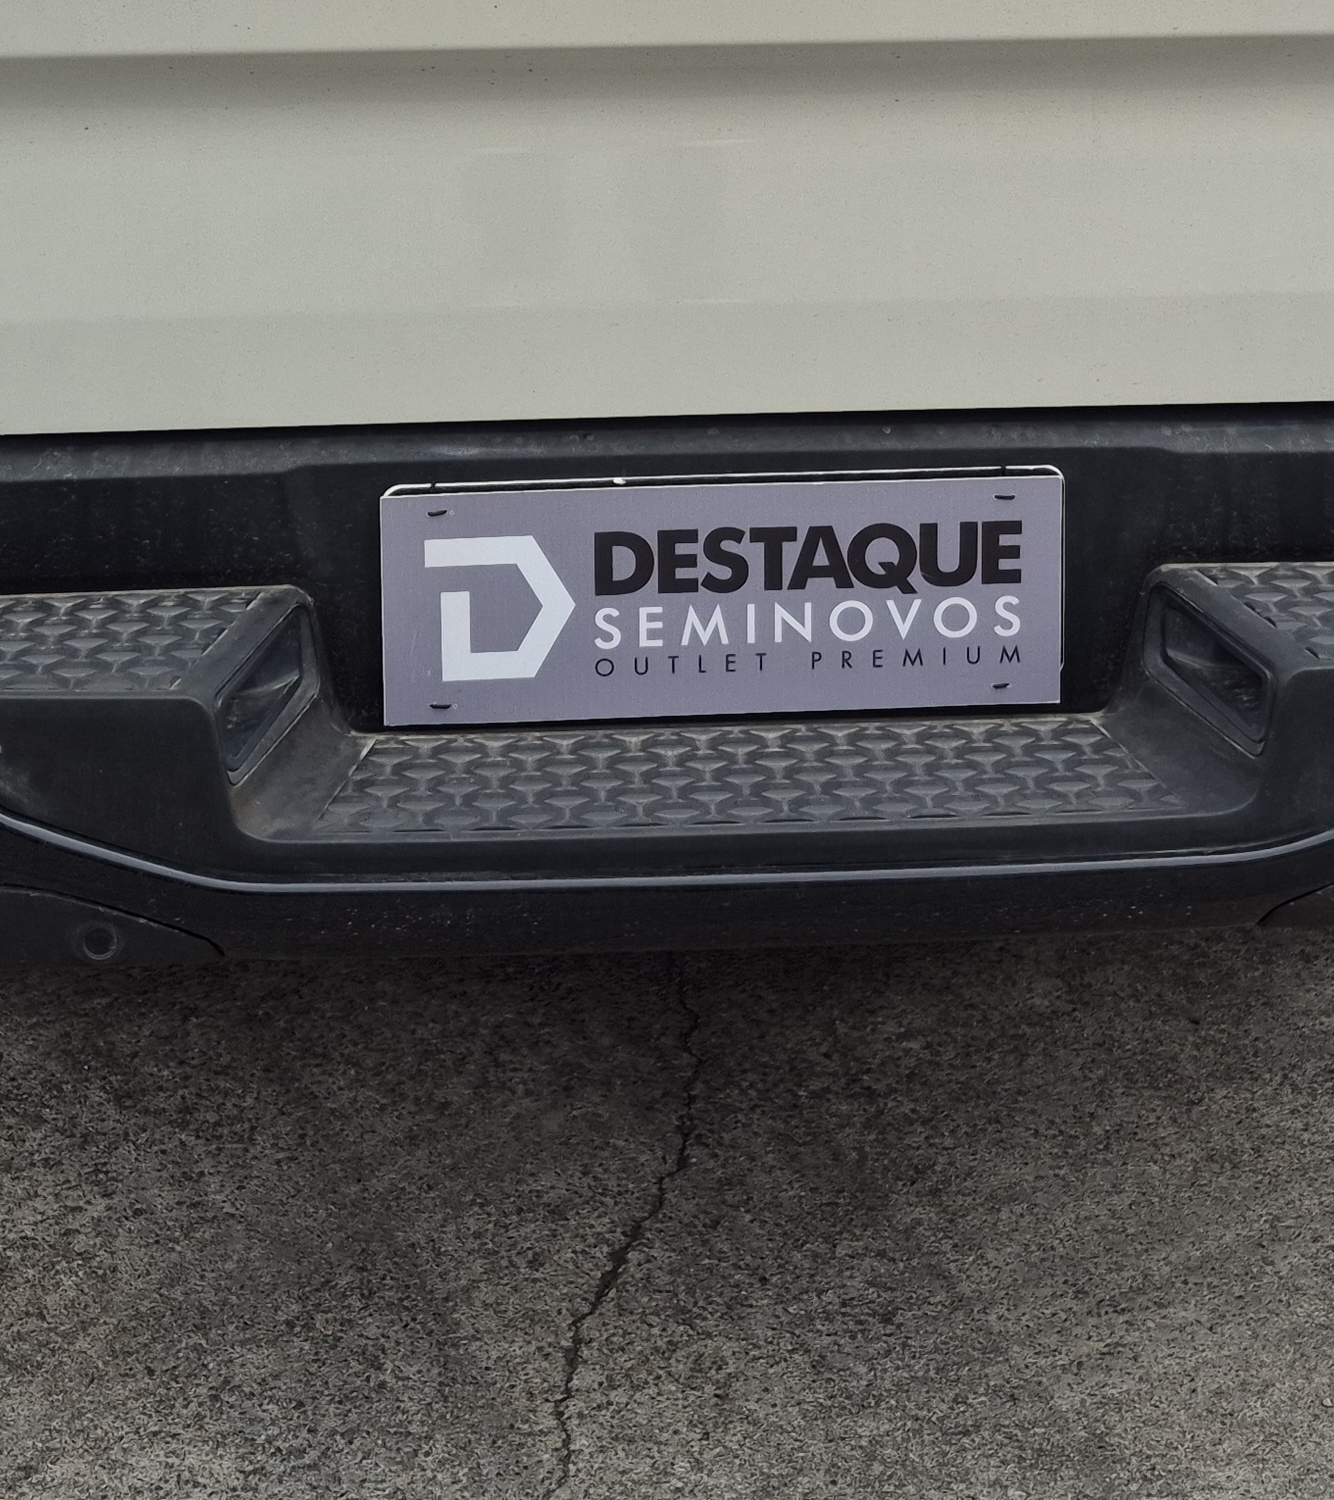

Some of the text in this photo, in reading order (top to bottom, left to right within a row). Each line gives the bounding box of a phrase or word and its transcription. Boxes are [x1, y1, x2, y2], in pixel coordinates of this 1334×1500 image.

[593, 519, 1024, 596] DESTAQUE
[593, 595, 1023, 651] SEMINOVOS
[594, 644, 1023, 678] OUTLET PREMIUM
